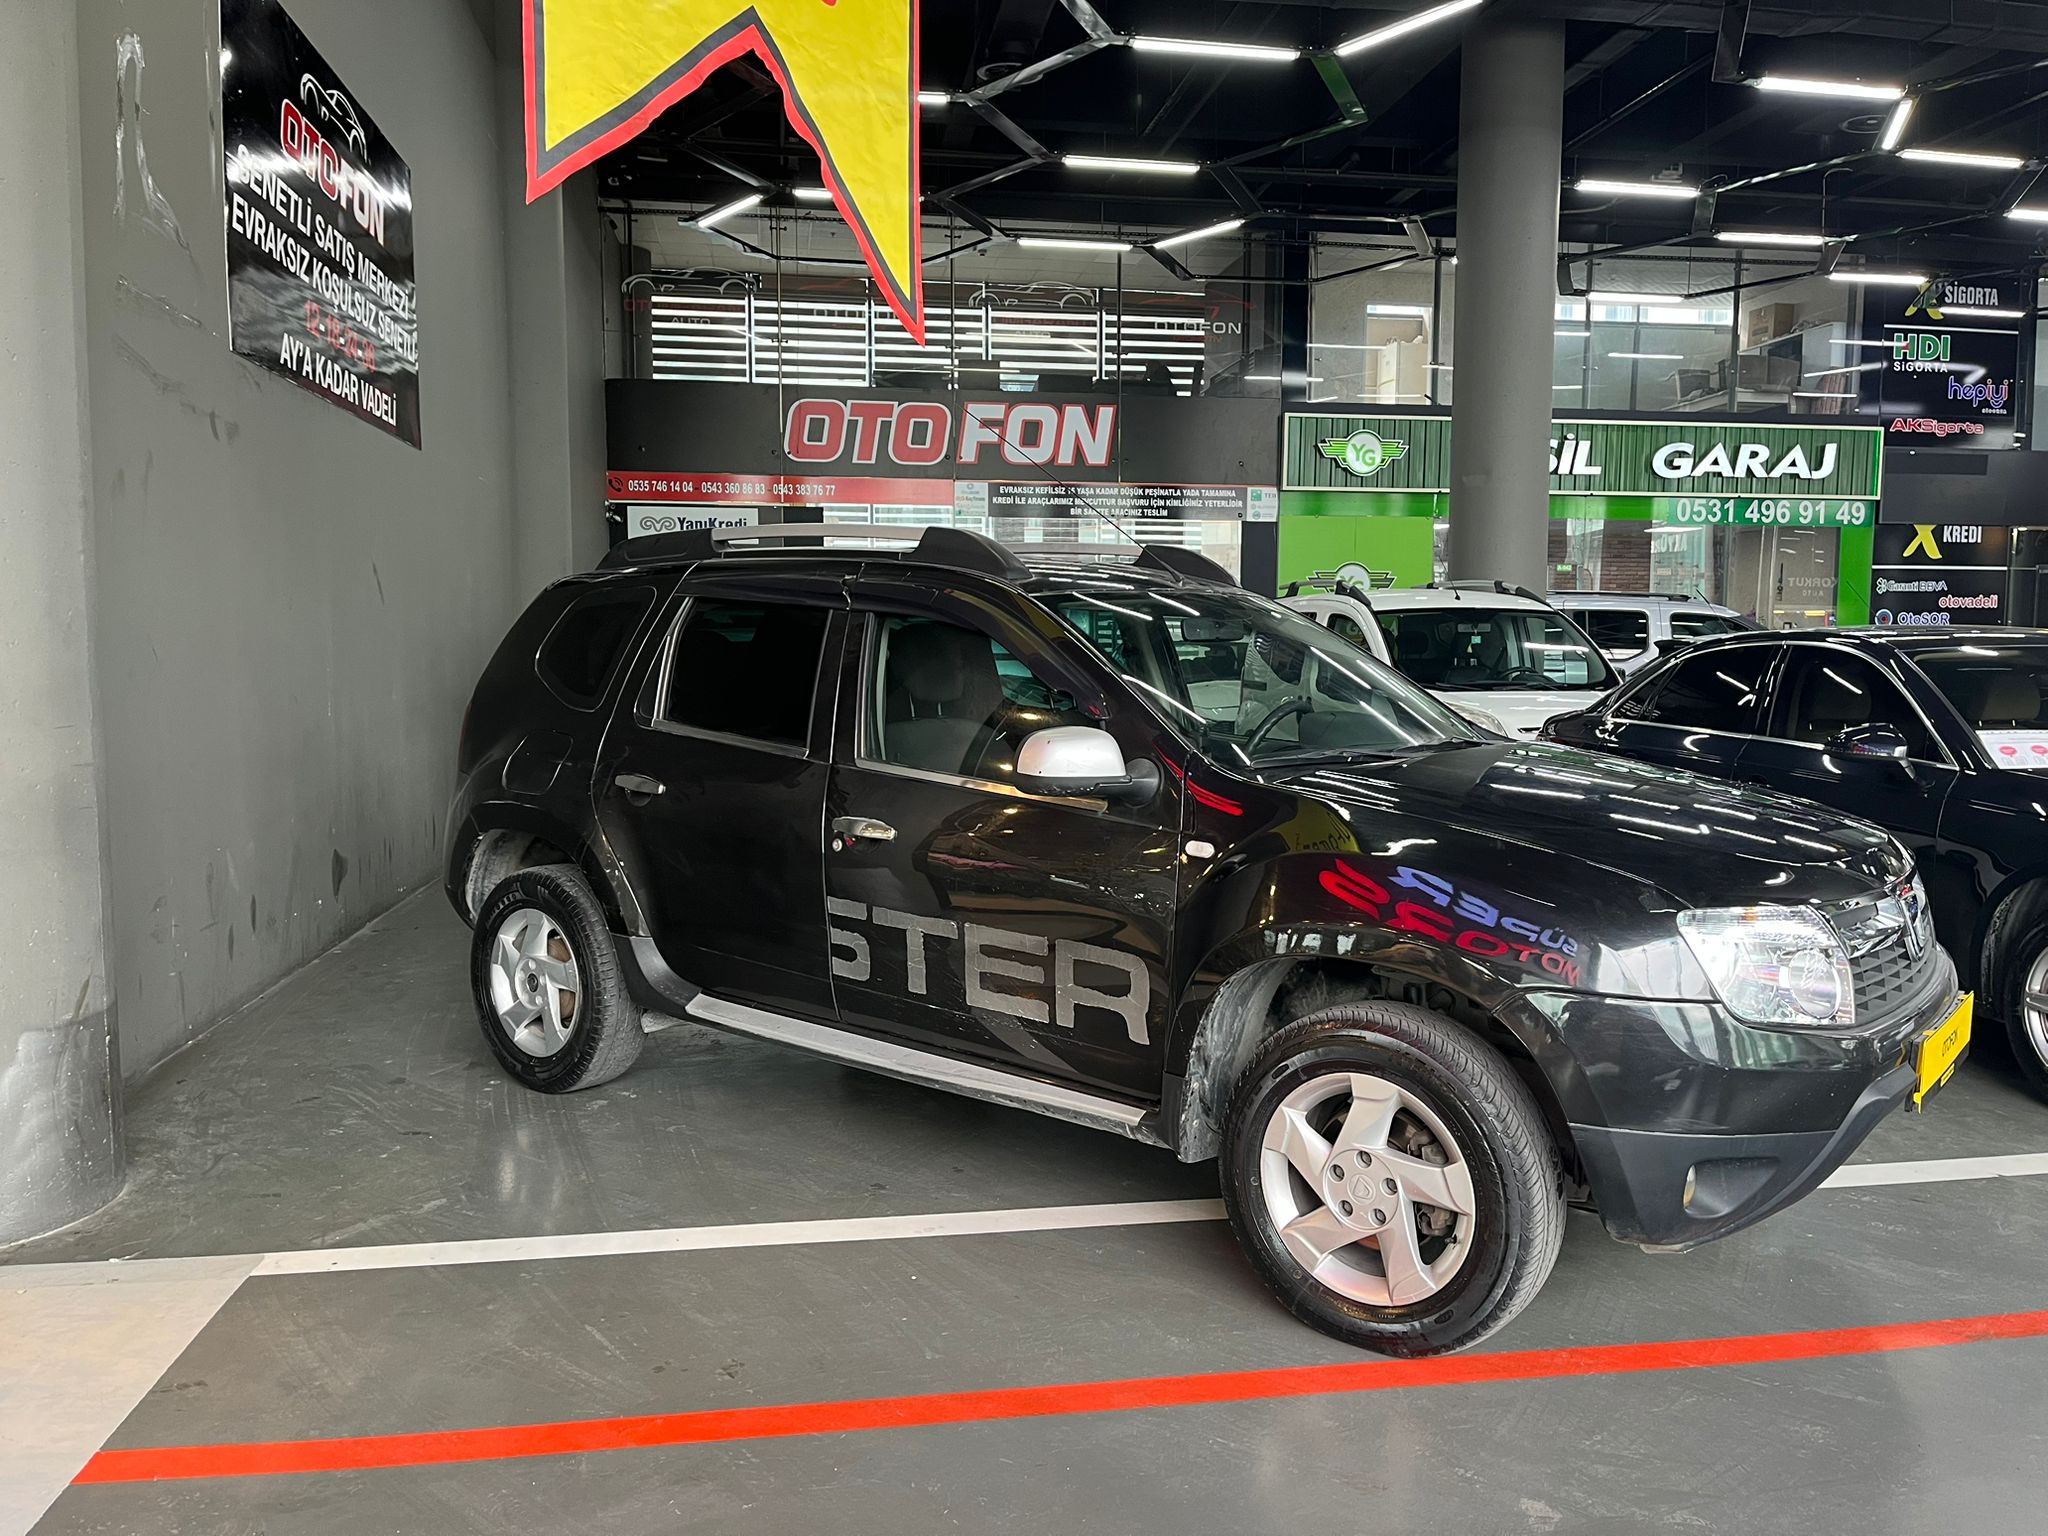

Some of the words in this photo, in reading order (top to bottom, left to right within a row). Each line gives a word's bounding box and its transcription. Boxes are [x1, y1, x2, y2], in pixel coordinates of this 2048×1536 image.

[237, 144, 312, 237] SENETLİ
[314, 213, 355, 281] SATIŞ
[357, 251, 409, 321] MERKEZİ
[232, 192, 310, 284] EVRAKSIZ
[313, 257, 377, 333] KOŞULSUZ
[1944, 281, 1999, 306] SİGORTA
[1893, 332, 1951, 362] HDI
[315, 352, 359, 406] KADAR
[361, 380, 397, 427] VADELİ
[1889, 417, 1985, 438] AKSigorta
[1350, 443, 1376, 467] YG
[1652, 442, 1837, 479] GARAJ
[628, 480, 650, 492] 0535
[651, 480, 668, 492] 746
[669, 481, 681, 492] 14
[682, 481, 694, 493] 04
[701, 481, 723, 493] 0543
[724, 482, 740, 494] 360
[742, 483, 753, 494] 86
[755, 483, 766, 495] 83
[772, 483, 794, 495] 0543
[795, 484, 811, 496] 383
[812, 484, 824, 496] 76
[825, 485, 836, 496] 77
[992, 496, 1014, 504] KREDİ
[1000, 486, 1034, 494] EVRAKSIZ
[1676, 498, 1735, 523] 0531
[1744, 500, 1791, 523] 496
[1798, 501, 1826, 524] 91
[1835, 502, 1866, 526] 49
[1938, 594, 1999, 609] otovadeli
[1897, 612, 1951, 625] OtoSOR
[827, 895, 1150, 1046] STER
